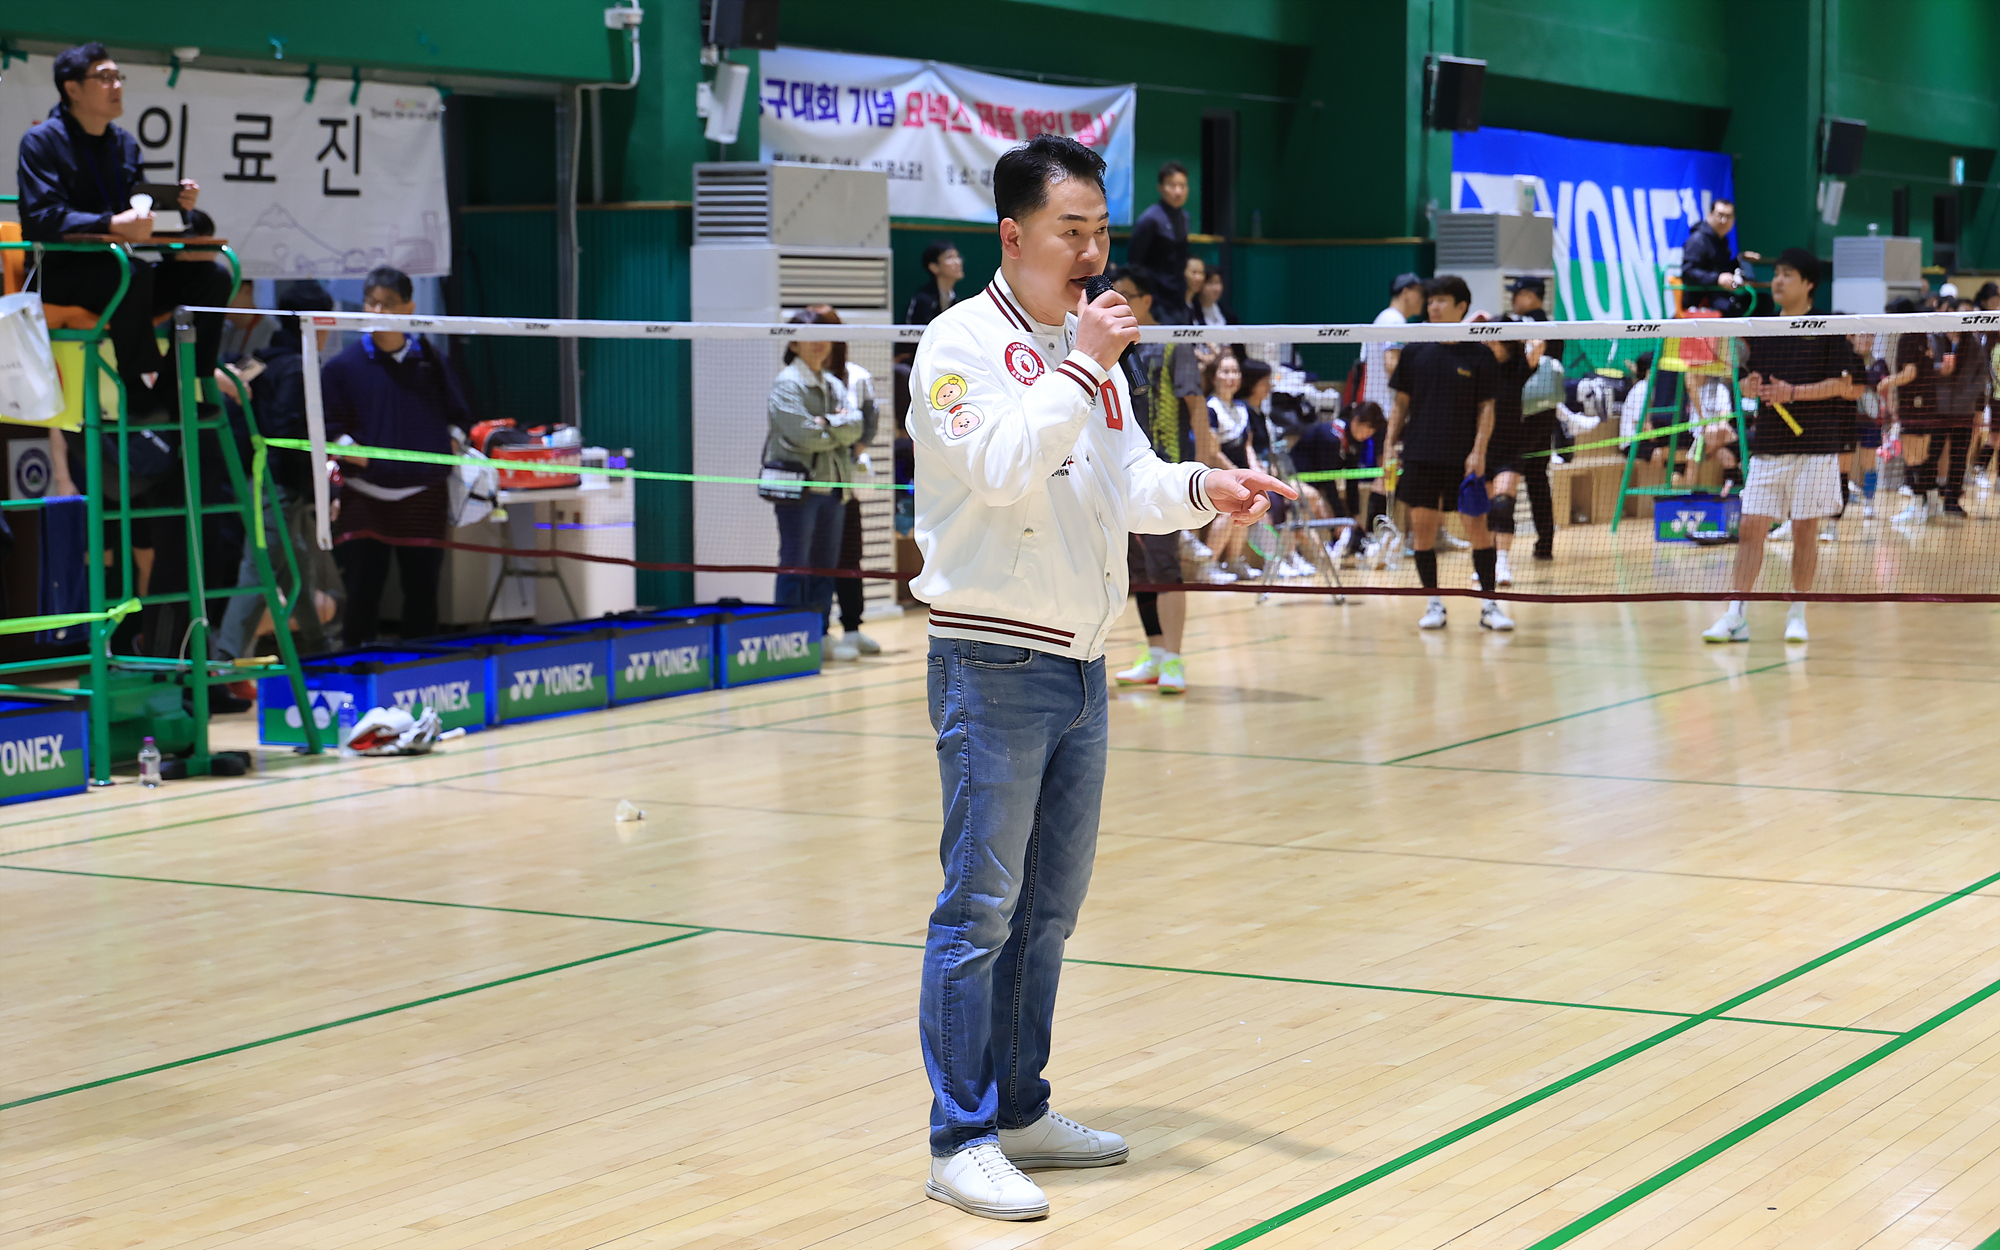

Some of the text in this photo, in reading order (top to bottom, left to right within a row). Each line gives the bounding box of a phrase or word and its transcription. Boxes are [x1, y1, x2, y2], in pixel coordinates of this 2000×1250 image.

[760, 78, 840, 125] 구대회
[848, 85, 896, 127] 기념
[902, 91, 973, 134] 요넥스
[974, 102, 1018, 140] 제품
[1099, 378, 1123, 431] D
[652, 645, 700, 679] YONEX
[763, 630, 811, 662] YONEX
[418, 680, 472, 714] YONEX
[541, 661, 594, 697] YONEX
[0, 733, 66, 777] ONEX
